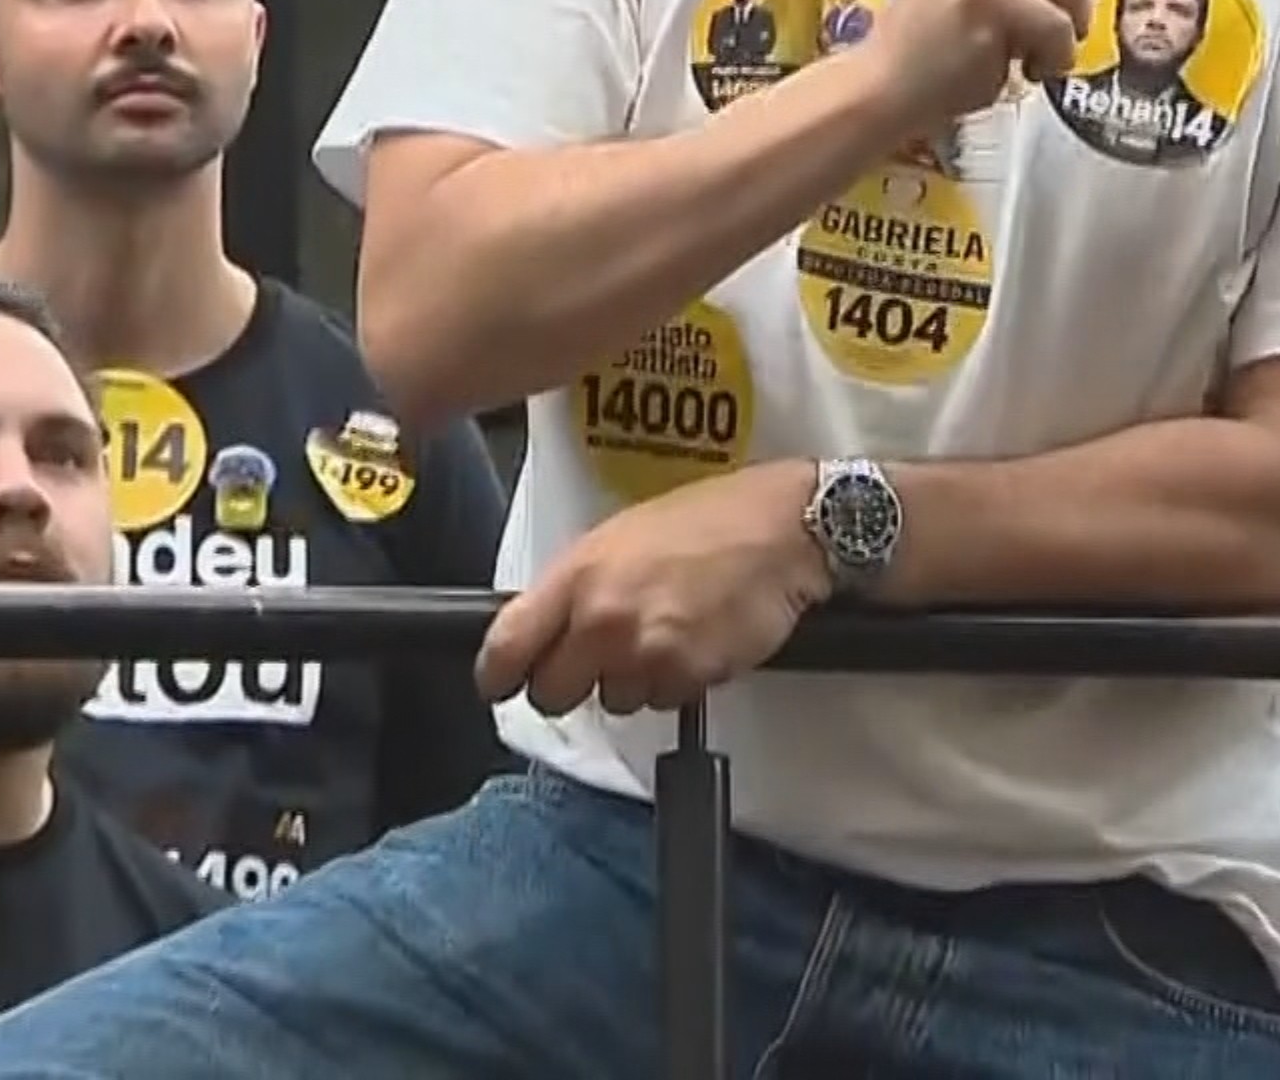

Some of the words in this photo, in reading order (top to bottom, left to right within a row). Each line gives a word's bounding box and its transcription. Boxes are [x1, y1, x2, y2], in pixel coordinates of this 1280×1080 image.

[821, 204, 985, 262] GABRIELA
[825, 285, 950, 354] 1404
[583, 374, 737, 444] 14000
